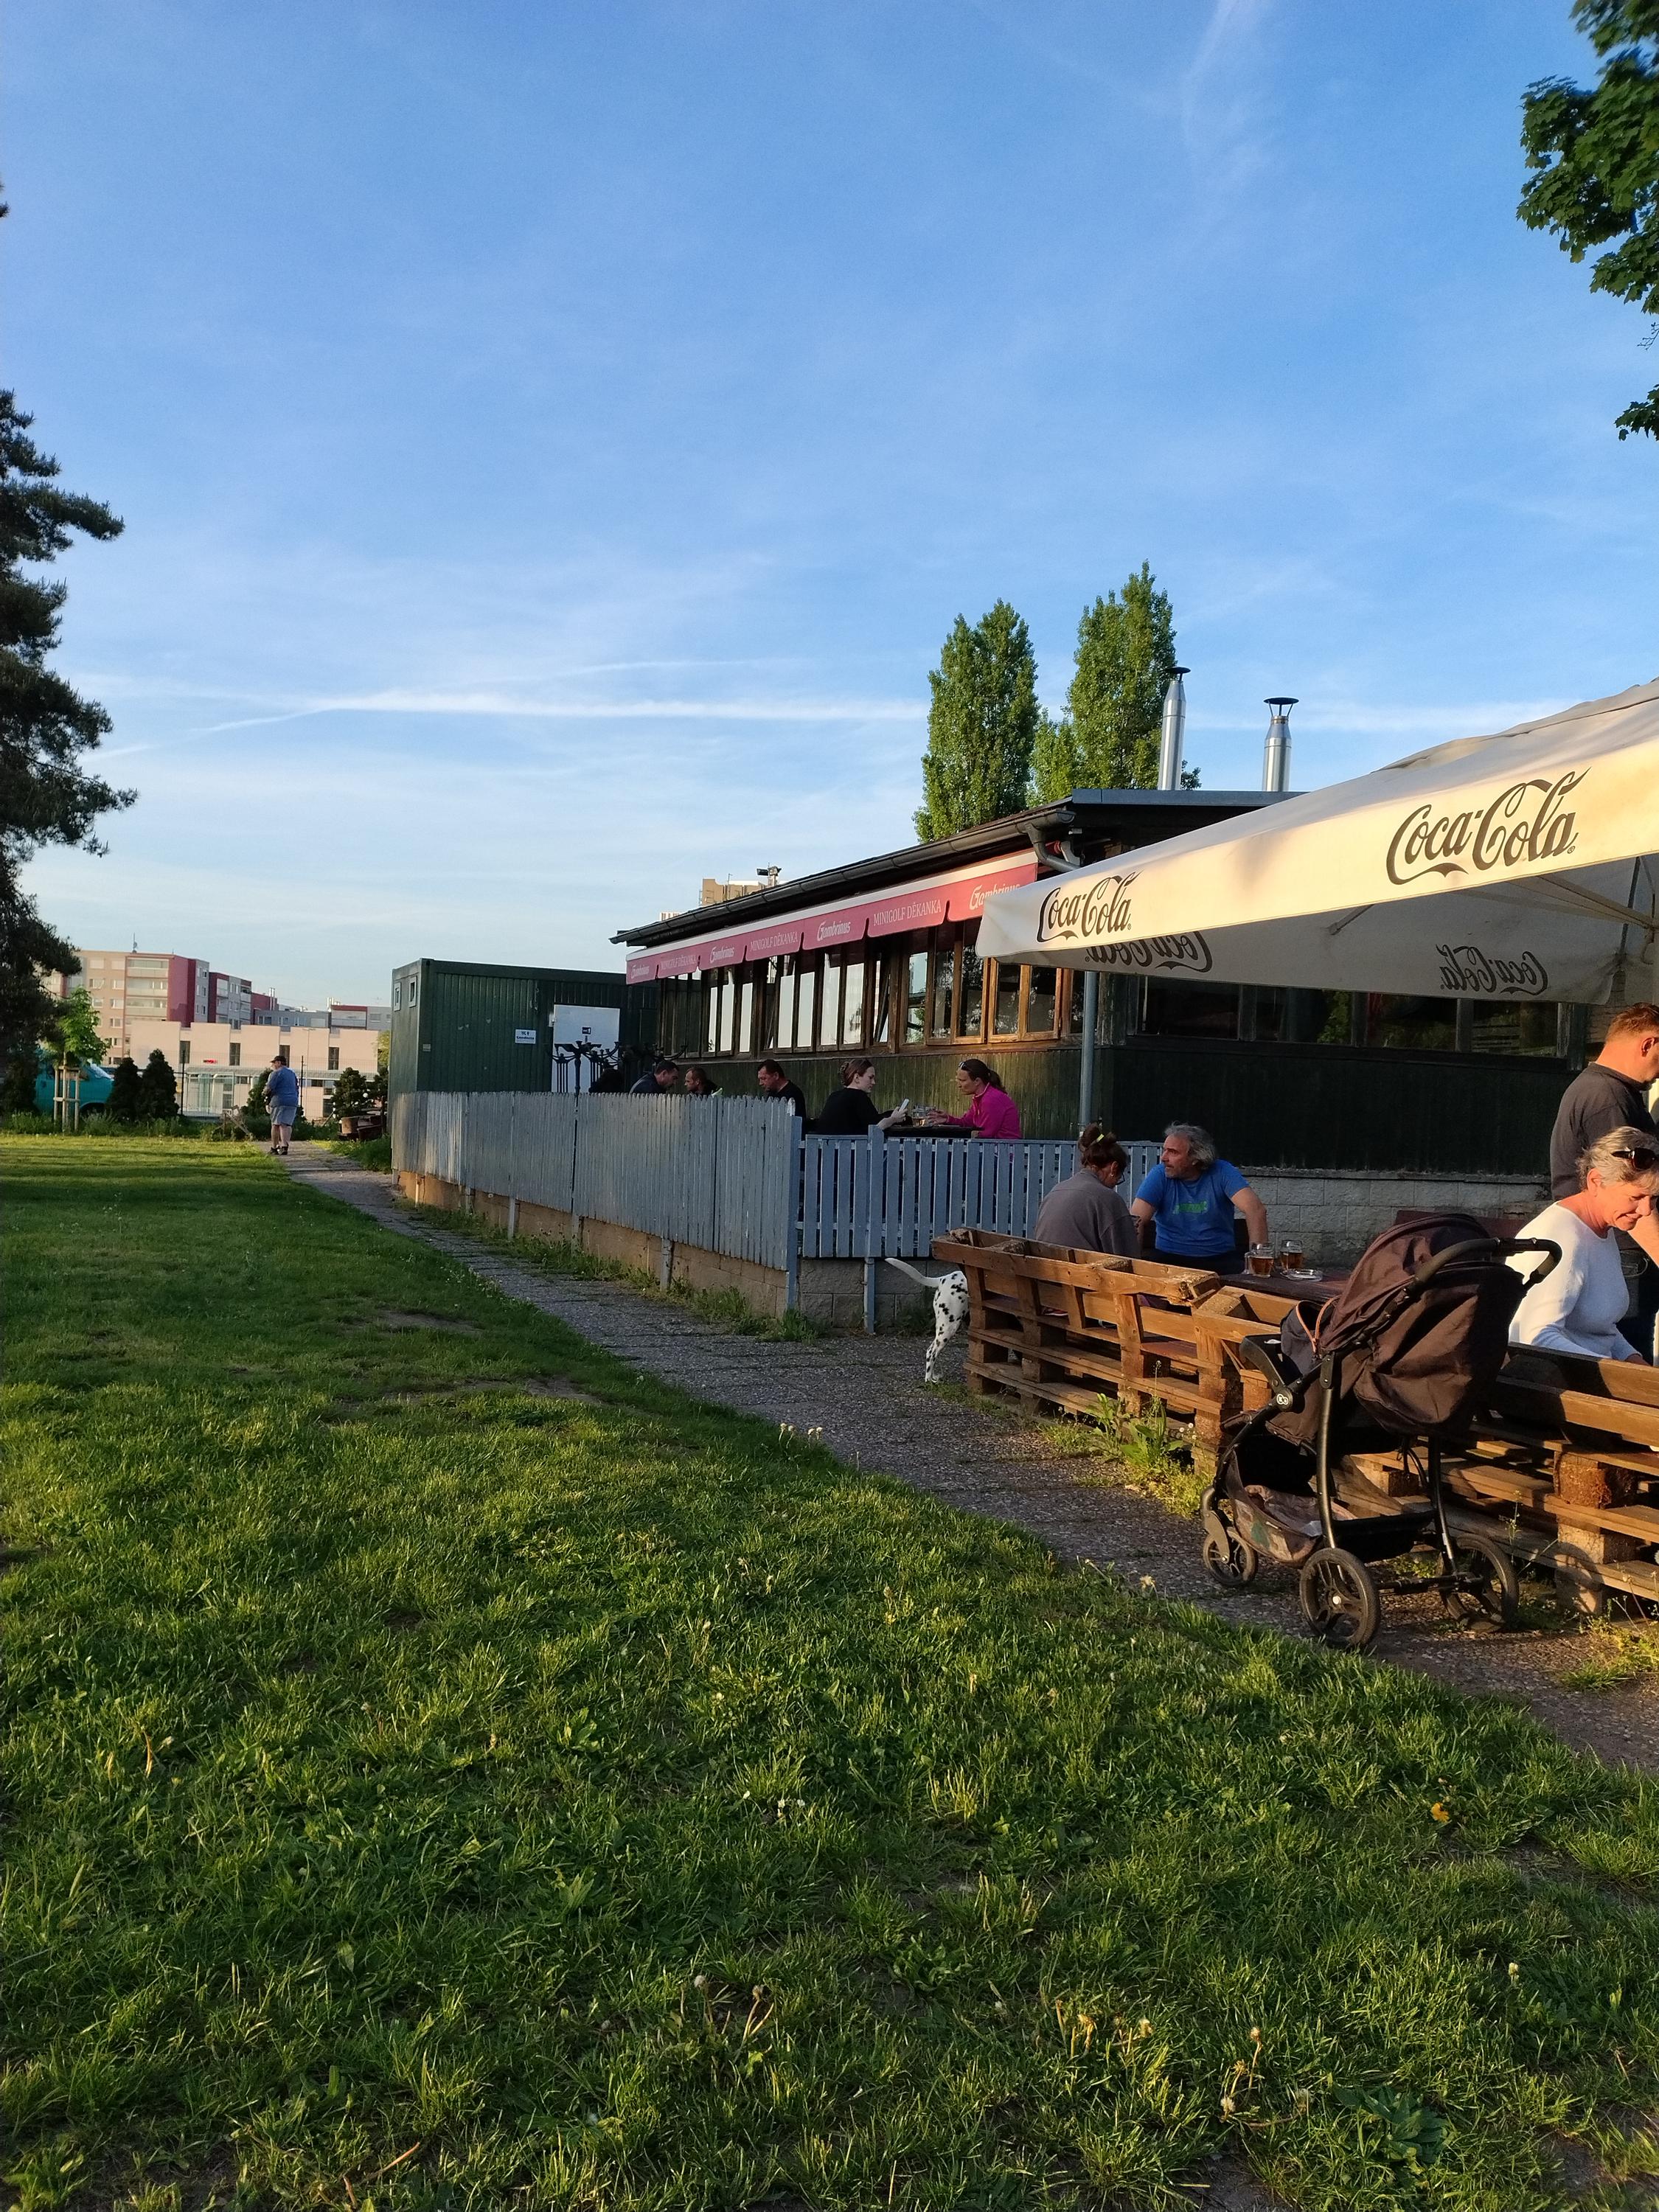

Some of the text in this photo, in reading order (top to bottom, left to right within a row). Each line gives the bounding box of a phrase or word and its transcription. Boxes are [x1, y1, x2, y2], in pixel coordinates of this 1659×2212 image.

[1386, 766, 1591, 885] Coca-Cola
[874, 899, 942, 926] MINIGOLF DĚKANKA
[1037, 869, 1144, 942] Coca-Cola
[750, 936, 773, 951] MINIGOLF
[817, 920, 851, 942] Gambrinus
